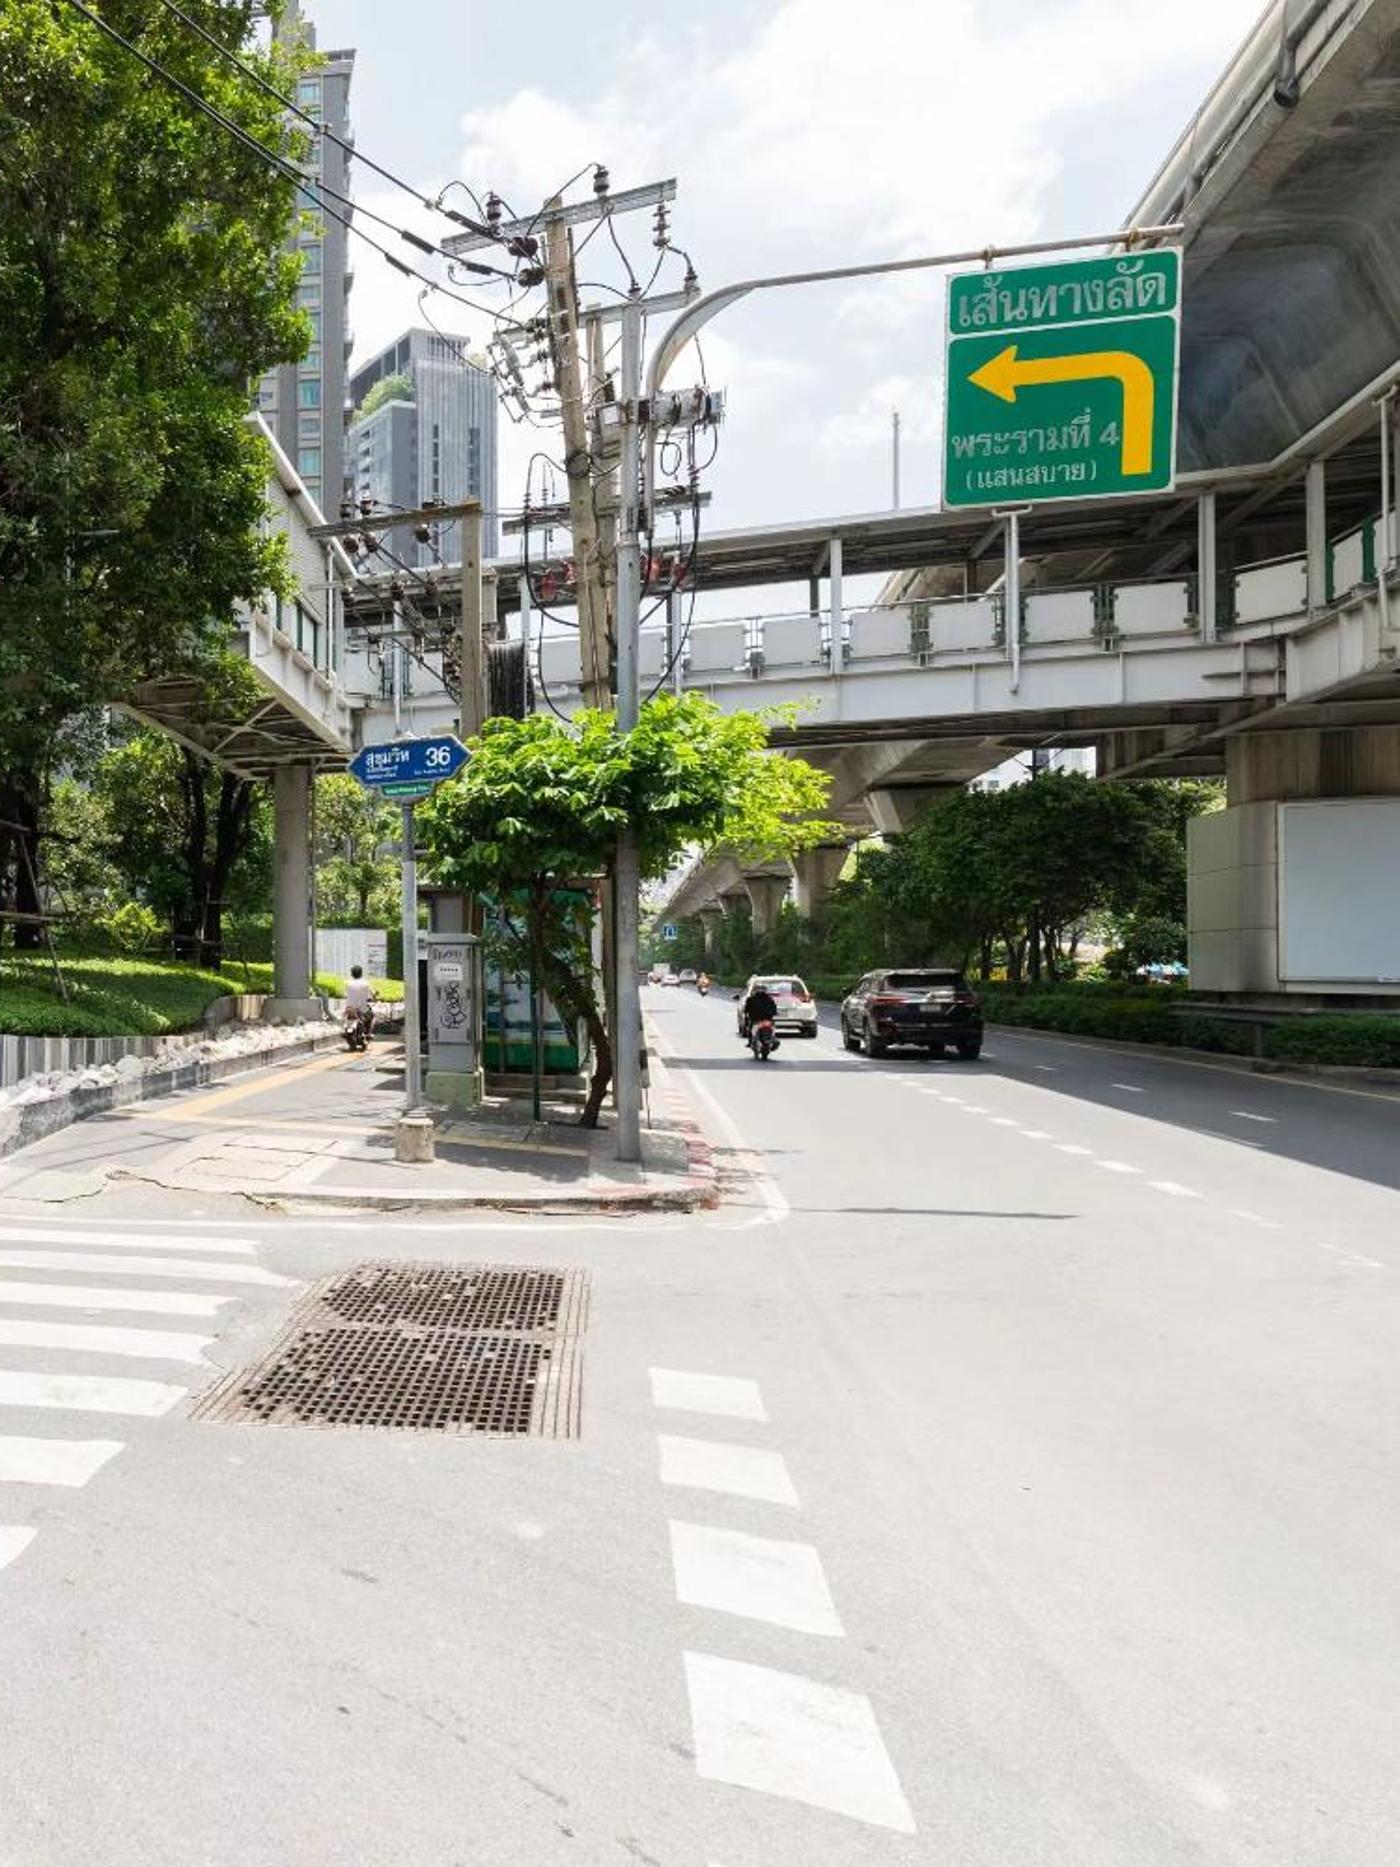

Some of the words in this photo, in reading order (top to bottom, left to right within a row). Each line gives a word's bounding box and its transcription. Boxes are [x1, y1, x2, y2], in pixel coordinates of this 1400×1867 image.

[959, 260, 1166, 326] เส้นทางลัด
[952, 407, 1091, 458] พระรามที่
[1099, 421, 1120, 446] 4
[967, 460, 1097, 490] (แสนสบาย)
[425, 746, 451, 766] 36
